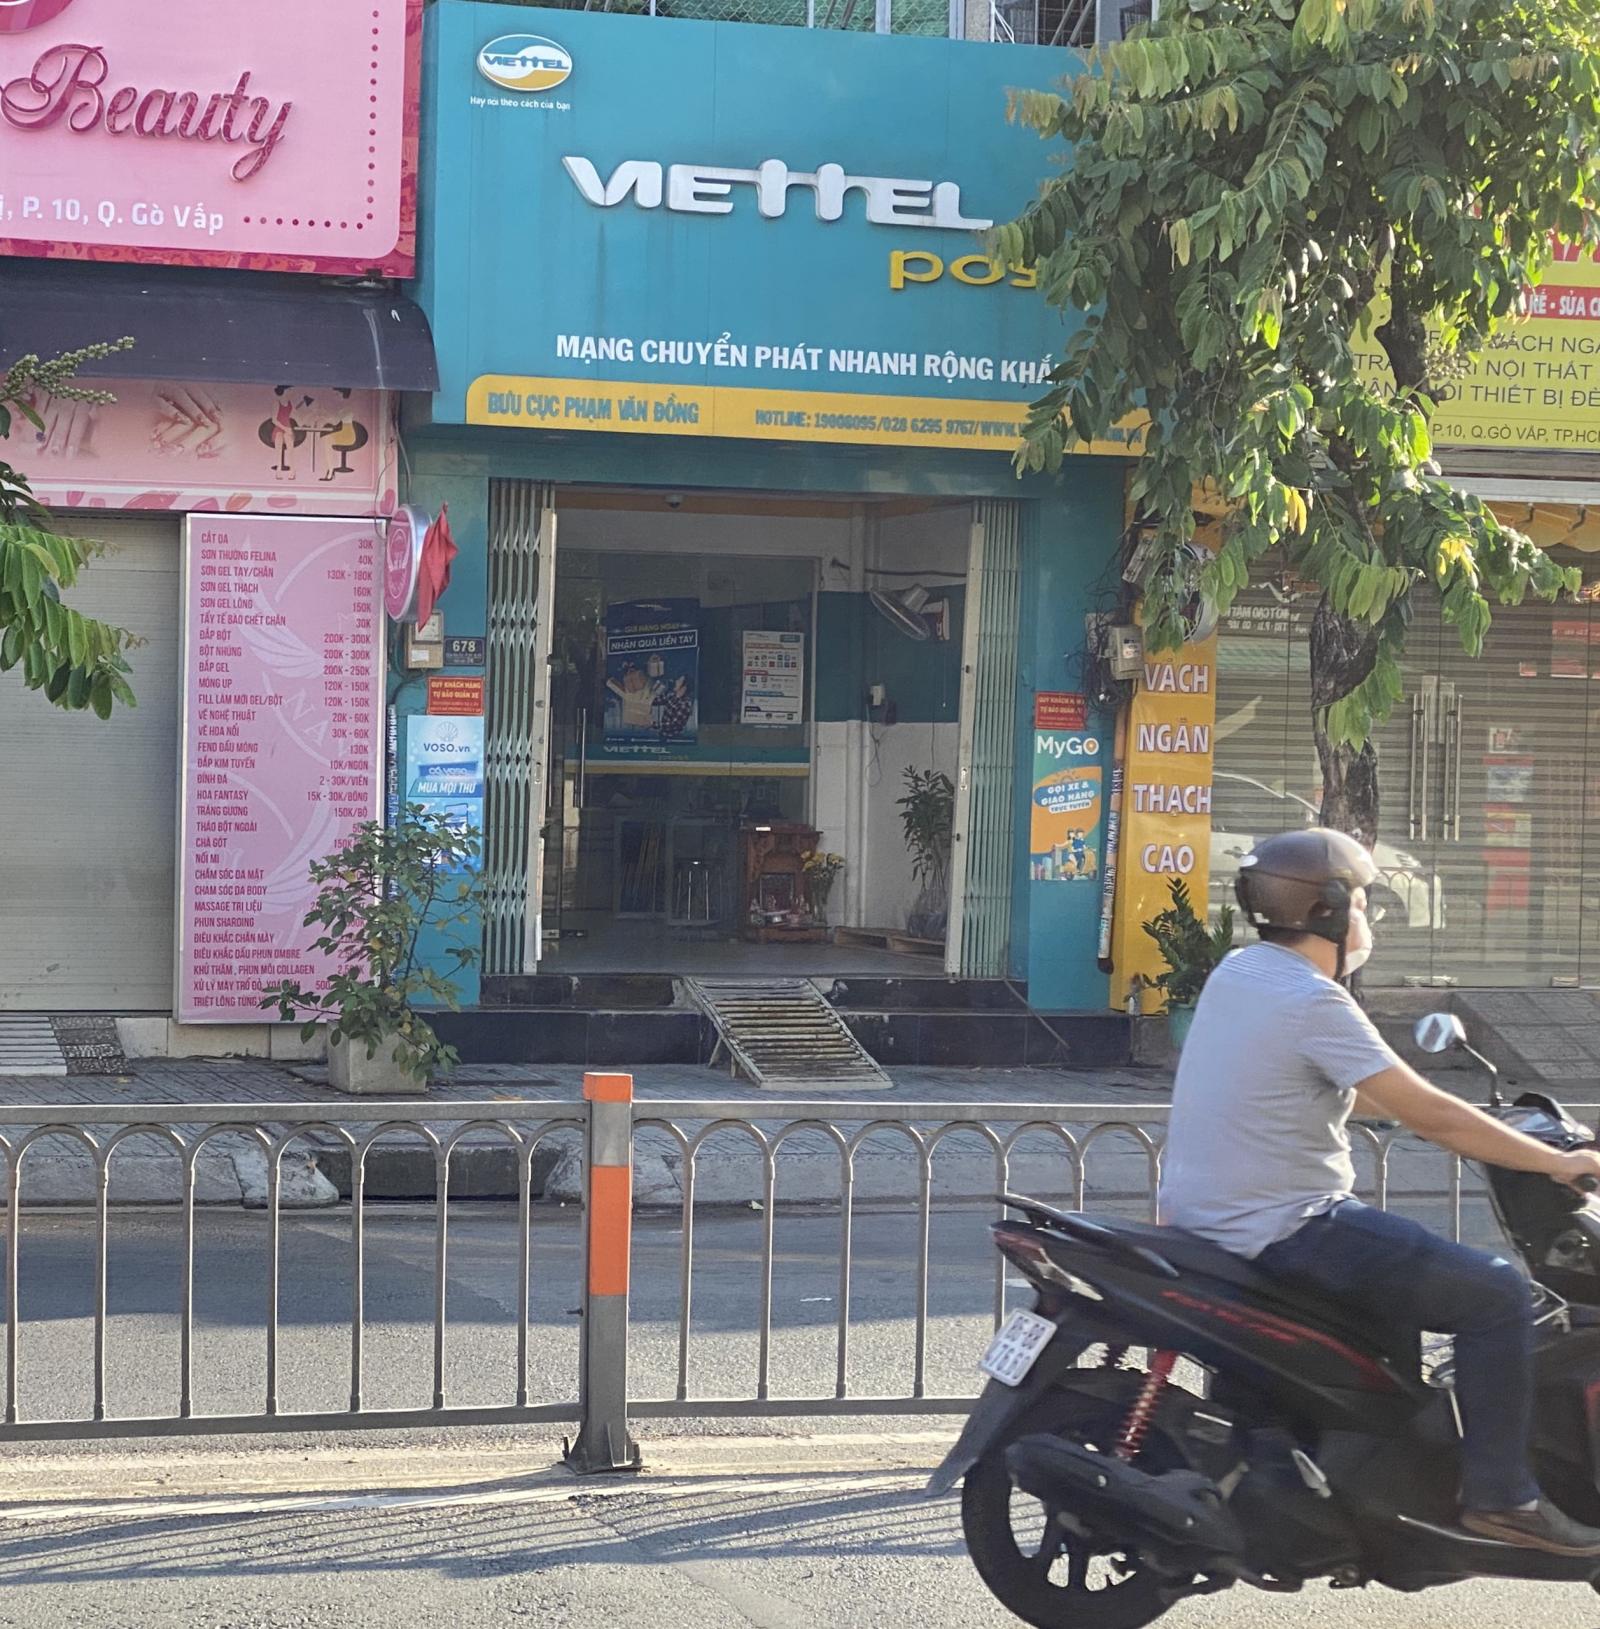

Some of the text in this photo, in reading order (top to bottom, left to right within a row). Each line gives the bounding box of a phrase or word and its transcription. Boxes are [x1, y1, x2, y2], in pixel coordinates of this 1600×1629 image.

[483, 55, 569, 69] VIETTEL
[501, 97, 518, 107] theo
[0, 43, 292, 182] Beauty
[561, 156, 993, 231] VIETTEL
[22, 196, 43, 219] P.
[52, 199, 89, 225] 10,
[97, 200, 123, 227] Q.
[131, 203, 164, 226] Gò
[173, 202, 224, 236] Vấp
[1559, 290, 1586, 316] SỬA
[557, 334, 633, 363] MẠNG
[640, 330, 748, 367] CHUYỂN
[755, 341, 820, 371] PHÁT
[828, 350, 916, 376] NHANH
[924, 349, 993, 384] RỘNG
[1486, 359, 1525, 380] NỘI
[1533, 361, 1593, 380] THẤT
[1470, 384, 1536, 404] THIẾT
[1544, 388, 1563, 408] BỊ
[526, 394, 560, 421] CỤC
[564, 396, 612, 423] PHẠM
[617, 395, 648, 422] VĂN
[653, 392, 699, 424] ĐỒNG
[755, 409, 811, 427] HOTLINE:
[1471, 424, 1511, 440] Q.GÒ
[358, 539, 373, 549] 30K
[250, 551, 276, 561] FELINA
[358, 556, 373, 565] 40K
[218, 566, 231, 576] GEL
[327, 570, 346, 580] 130K
[218, 582, 231, 592] GEL
[234, 583, 258, 594] THẠCH
[217, 599, 231, 608] GEL
[353, 602, 371, 612] 150K
[356, 619, 371, 628] 30K
[324, 633, 344, 643] 200K
[351, 634, 371, 644] 300K
[678, 634, 694, 644] TAY
[453, 640, 476, 652] 678
[324, 649, 343, 659] 200K
[351, 650, 370, 660] 300K
[216, 662, 229, 672] GEL
[323, 665, 343, 675] 200K
[350, 666, 370, 676] 250K
[222, 679, 232, 688] UP
[324, 681, 343, 691] 120K
[351, 682, 370, 692] 150K
[198, 694, 214, 705] FILL
[324, 697, 342, 707] 120K
[351, 698, 370, 707] 150K
[332, 713, 347, 723] 20K
[209, 726, 225, 736] HOA
[332, 729, 347, 738] 30K
[1138, 718, 1209, 753] NGĂN
[198, 742, 217, 752] FEND
[350, 745, 368, 754] 130K
[424, 743, 470, 753] VOSO.vn
[1037, 735, 1099, 758] MyGO
[214, 759, 229, 768] KIM
[320, 776, 325, 785] 2
[418, 782, 439, 793] MUA
[439, 782, 457, 795] MỌI
[1048, 785, 1065, 795] GỌI
[1068, 782, 1079, 792] XE
[197, 790, 212, 800] HOA
[214, 790, 248, 800] FANTASY
[307, 792, 321, 801] 15K
[1041, 795, 1065, 806] GIAO
[1133, 784, 1211, 816] THẠCH
[210, 854, 219, 863] MI
[1143, 844, 1194, 873] CAO
[235, 870, 245, 879] DA
[235, 886, 245, 895] DA
[247, 886, 267, 895] BODY
[194, 899, 262, 914] MASSAGE TRỊ LIỆU
[194, 917, 214, 927] PHUN
[252, 949, 272, 959] PHUN
[274, 949, 301, 959] OMBRE
[239, 965, 258, 974] PHUN
[277, 965, 314, 974] COLLAGEN
